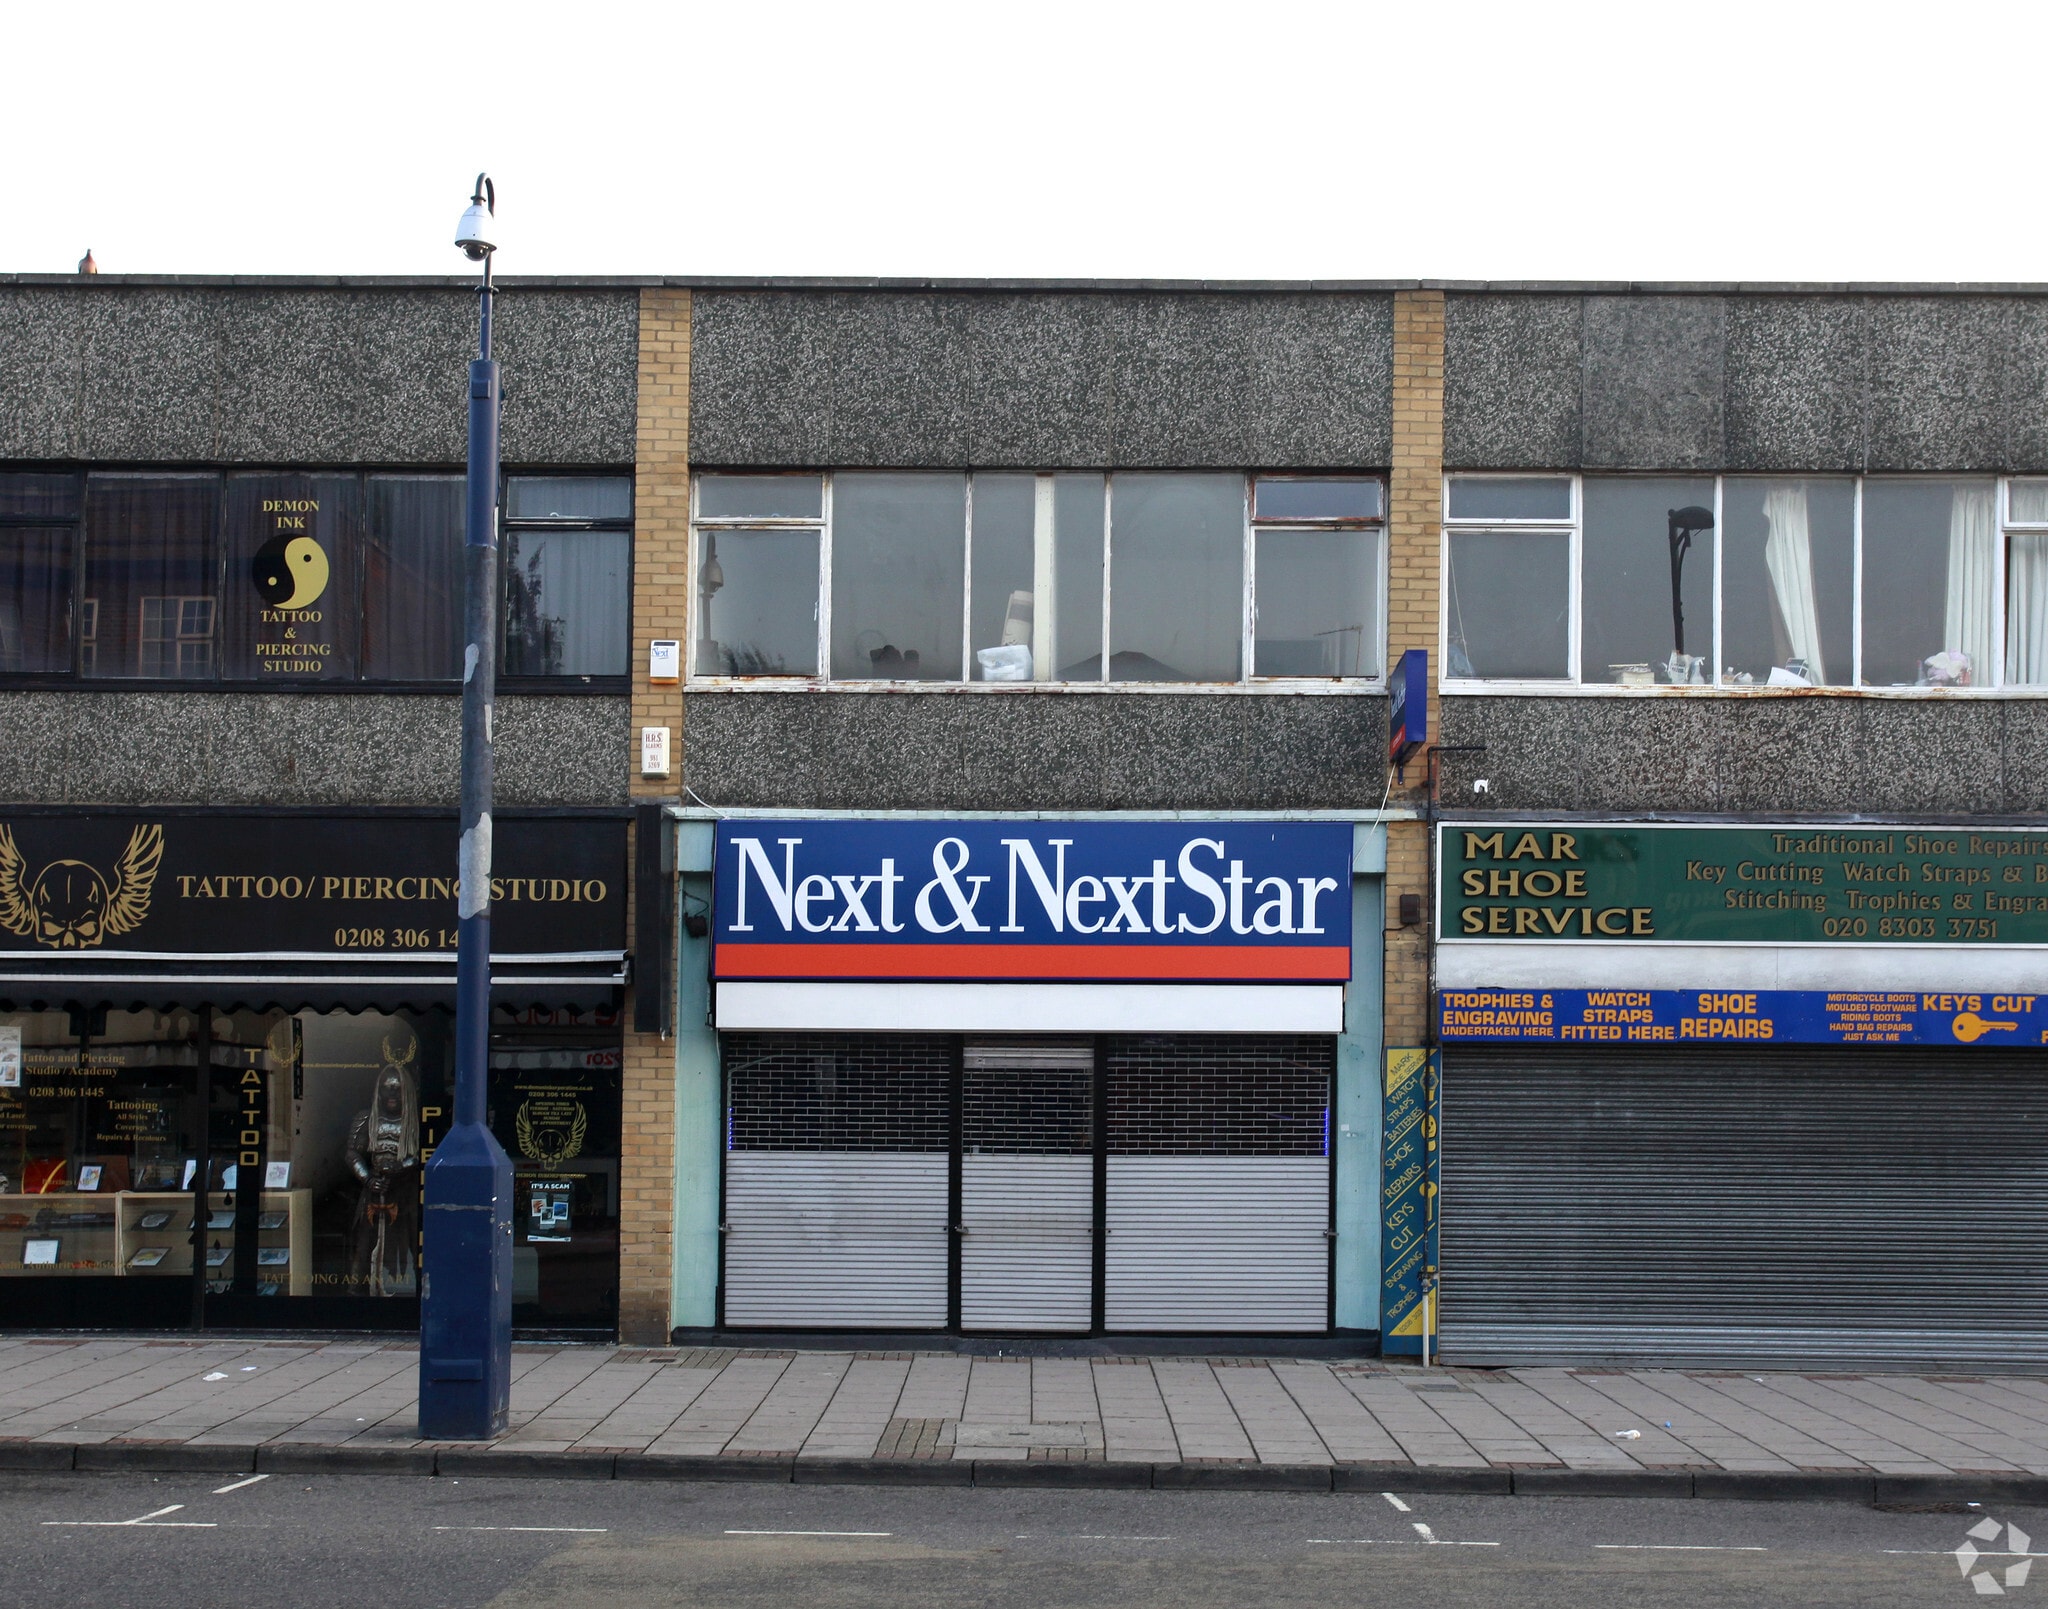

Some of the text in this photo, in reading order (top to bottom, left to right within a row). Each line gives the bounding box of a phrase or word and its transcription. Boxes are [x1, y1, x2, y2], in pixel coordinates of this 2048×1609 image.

[263, 500, 320, 512] DEMON
[277, 516, 305, 528] INK
[260, 610, 322, 622] TATTOO
[284, 627, 296, 639] &
[256, 644, 331, 655] PIERCING
[264, 660, 322, 672] STUDIO
[1464, 832, 1580, 860] MAR
[1771, 833, 2048, 859] Traditional Shoe Repairs
[1686, 860, 1727, 884] Key
[1737, 861, 1825, 885] Cutting
[1843, 862, 1911, 882] Watch
[1921, 863, 1991, 886] Straps
[2002, 866, 2023, 883] &
[490, 878, 607, 902] STUDIO
[728, 838, 905, 933] Next
[914, 837, 991, 933] &
[1462, 869, 1588, 897] SHOE
[1725, 888, 1827, 913] Stitching
[1845, 890, 1941, 913] Trophies
[1952, 894, 1974, 911] &
[1461, 907, 1655, 934] SERVICE
[1823, 917, 1998, 938] 020 8303 3751
[335, 928, 459, 947] 0208 306 14
[1443, 993, 1554, 1008] TROPHIES &
[1587, 993, 1651, 1006] WATCH
[1698, 994, 1757, 1013] SHOE
[1827, 993, 1916, 1002] MOTORCYCLE BOOTS
[1923, 995, 2036, 1013] KEYS CUT
[1826, 1003, 1917, 1012] MOULDED FOOTWARE
[1443, 1011, 1553, 1026] ENGRAVING
[1583, 1009, 1653, 1023] STRAPS
[1841, 1013, 1901, 1022] RIDING BOOTS
[1442, 1026, 1554, 1036] UNDERTAKEN HERE
[1561, 1026, 1675, 1040] FITTED HERE
[1680, 1018, 1774, 1039] REPAIRS
[1829, 1023, 1913, 1032] HAND BAG REPAIRS
[1843, 1033, 1900, 1041] JUST ASK ME
[23, 1053, 126, 1064] Tattoo and Piercing
[1390, 1052, 1414, 1076] MARK
[25, 1066, 60, 1076] Studio
[69, 1066, 119, 1078] Academy
[29, 1088, 105, 1097] 0208 306 1445
[1388, 1076, 1418, 1104] WATCH
[107, 1100, 158, 1112] Tattooing
[240, 1048, 262, 1166] TATTOO
[1386, 1096, 1415, 1124] STRAPS
[115, 1123, 148, 1131] Coverups
[1387, 1106, 1423, 1141] BATTERIES
[96, 1134, 123, 1142] Repairs
[1385, 1141, 1415, 1170] SHOE
[1384, 1162, 1421, 1199] REPAIRS
[1385, 1201, 1415, 1230] KEYS
[1390, 1225, 1414, 1250] CUT
[1384, 1250, 1423, 1288] ENGRAVING
[343, 1273, 359, 1284] AS
[1398, 1283, 1407, 1291] &
[1386, 1288, 1418, 1319] TROPHIES
